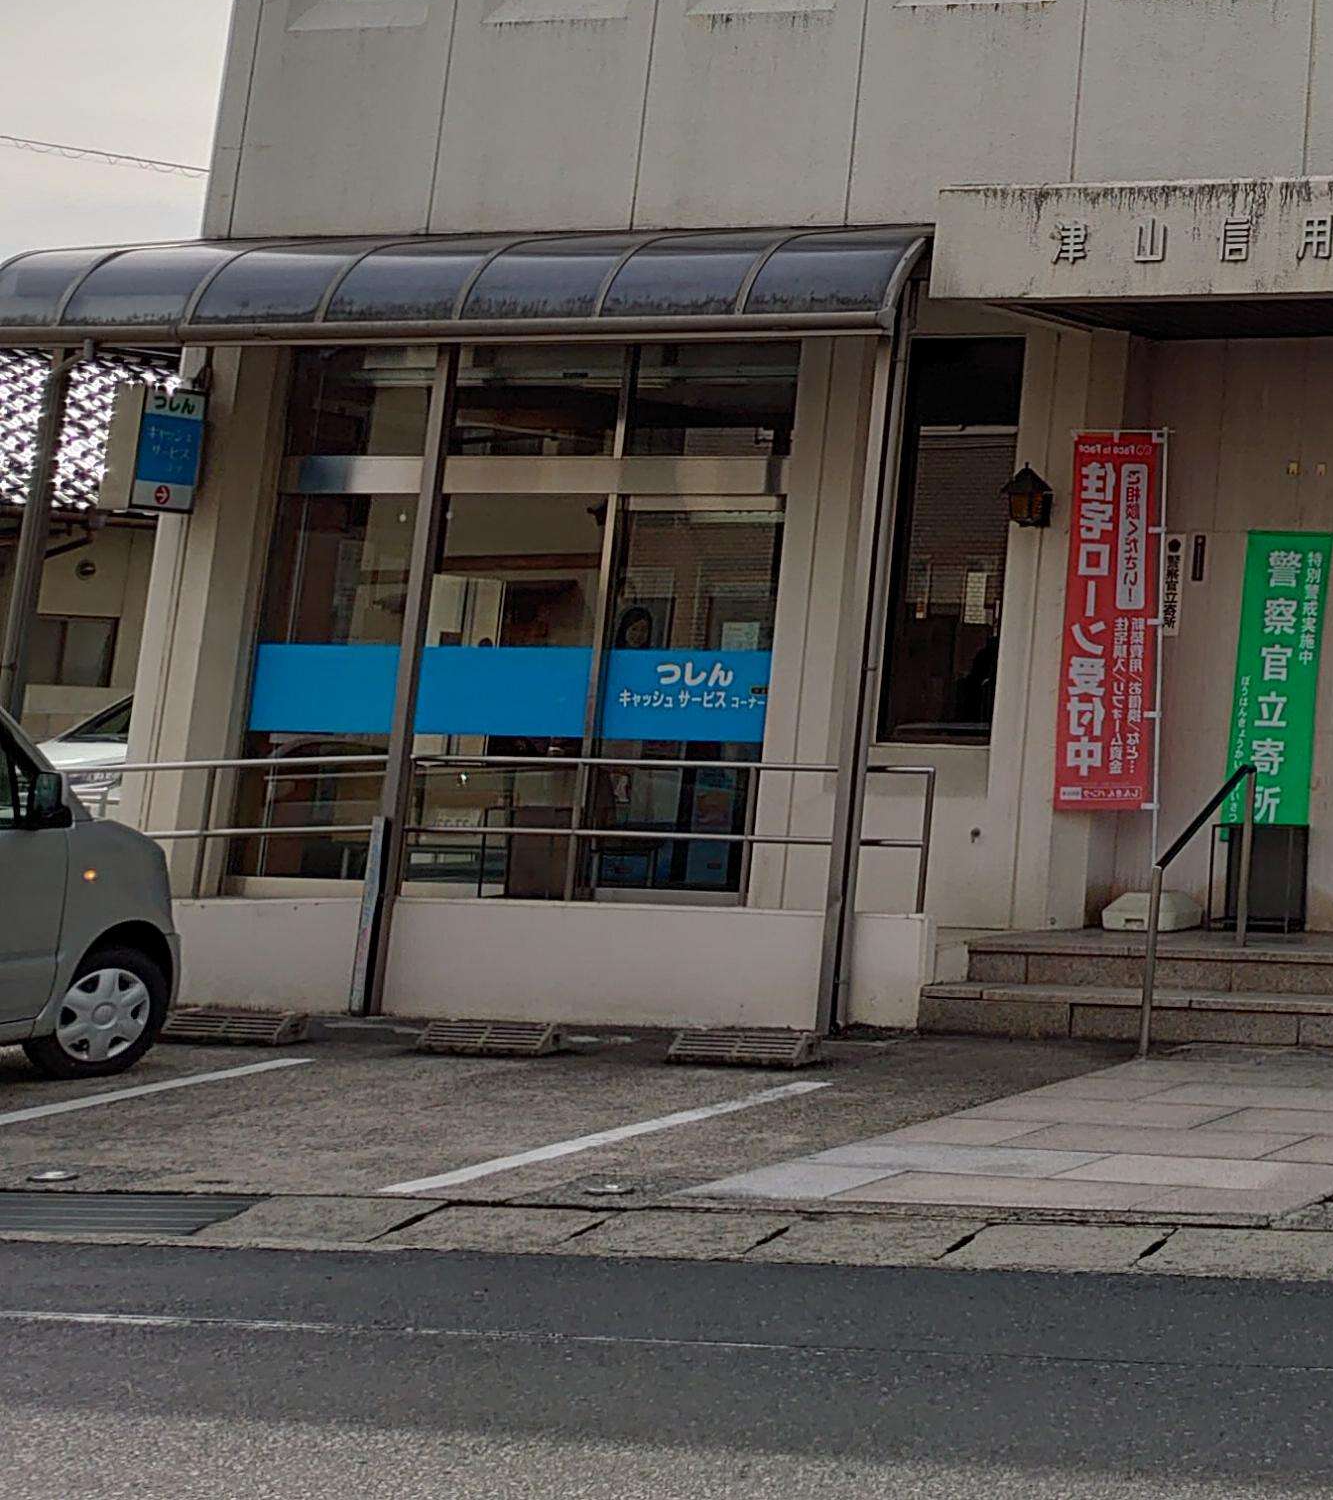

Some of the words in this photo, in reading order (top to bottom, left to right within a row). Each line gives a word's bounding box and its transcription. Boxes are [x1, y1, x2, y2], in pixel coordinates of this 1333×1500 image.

[154, 396, 195, 414] つしん
[1162, 554, 1181, 629] 警察官立寄所
[1298, 550, 1323, 666] 特別警戒実施中
[618, 689, 674, 708] キャッシュ
[678, 690, 727, 709] サービス
[731, 696, 766, 709] コーナー
[656, 661, 735, 687] つしん
[1250, 549, 1303, 823] 警察官立寄所
